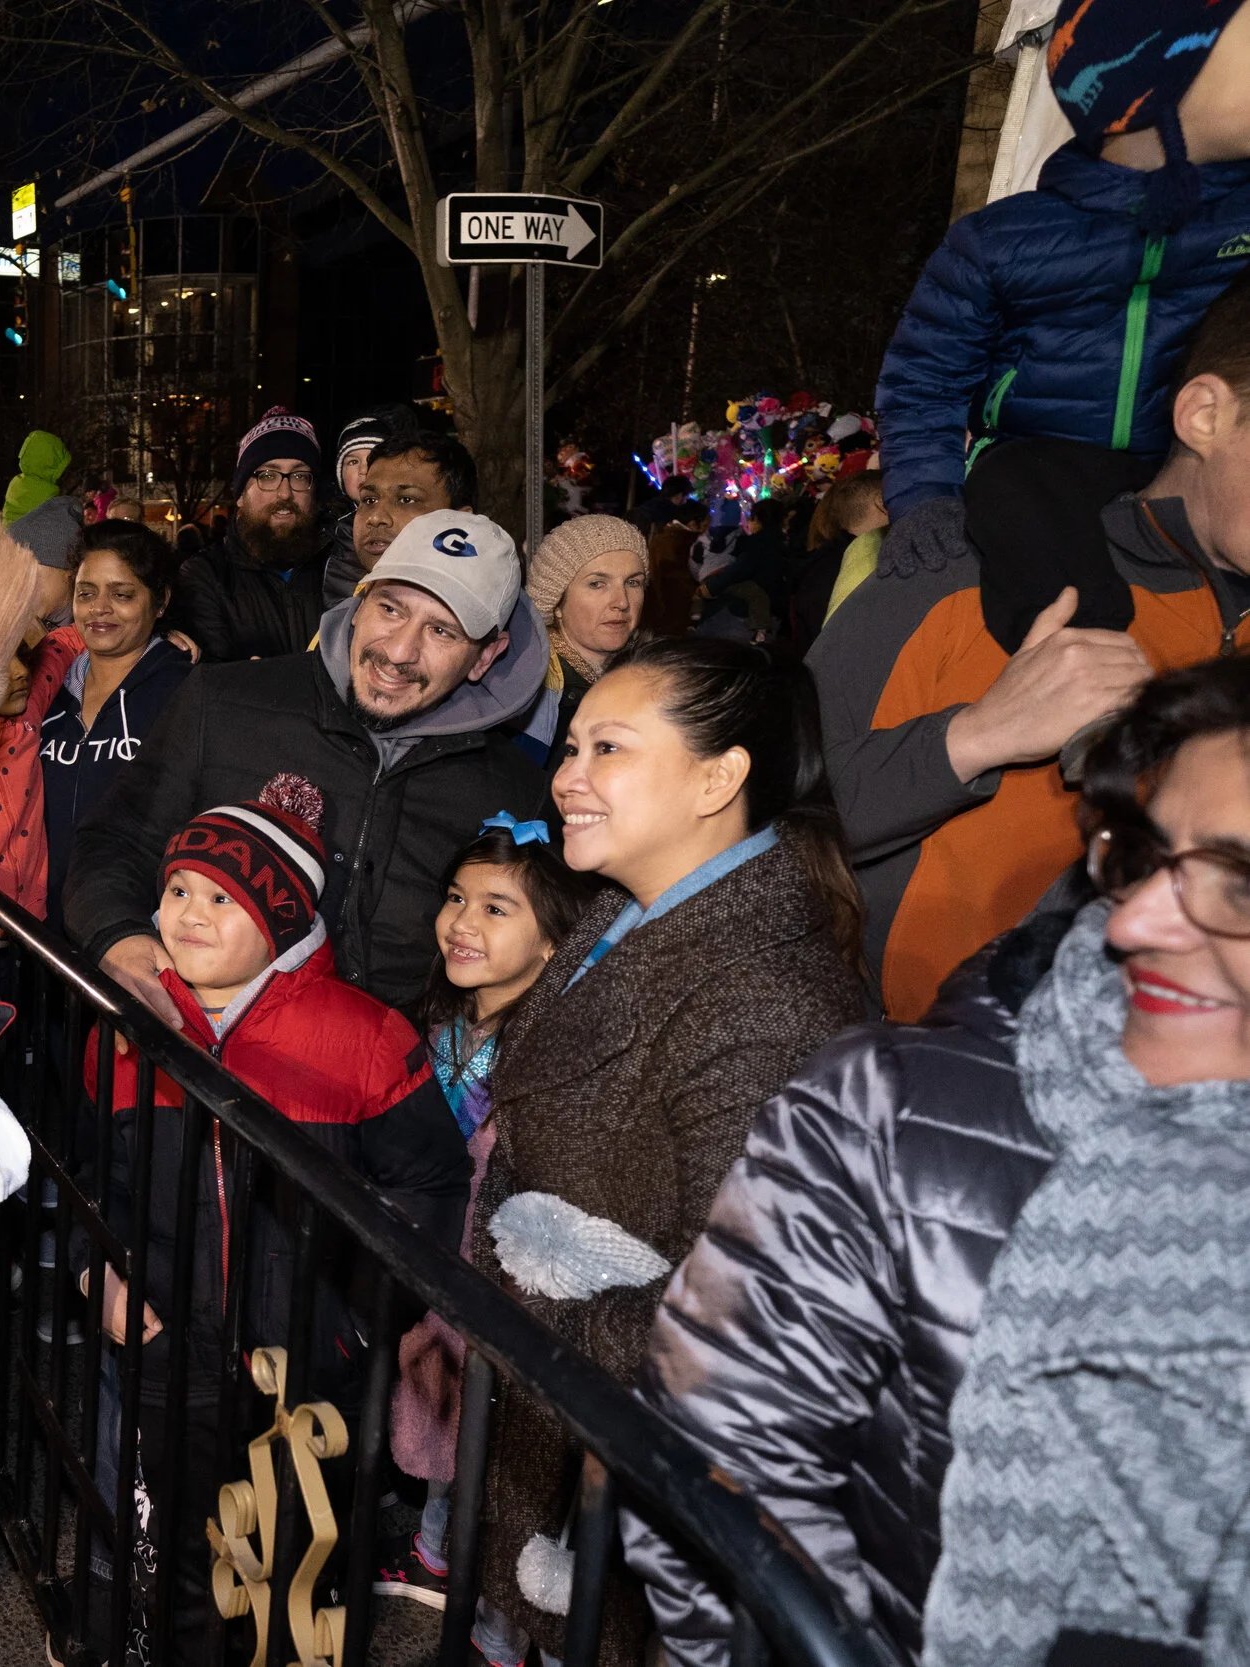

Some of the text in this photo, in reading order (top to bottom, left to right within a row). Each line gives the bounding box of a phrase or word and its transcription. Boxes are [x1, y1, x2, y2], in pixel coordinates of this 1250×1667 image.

[468, 215, 565, 242] ONE WAY
[432, 528, 478, 557] G
[39, 737, 142, 765] AUTIC
